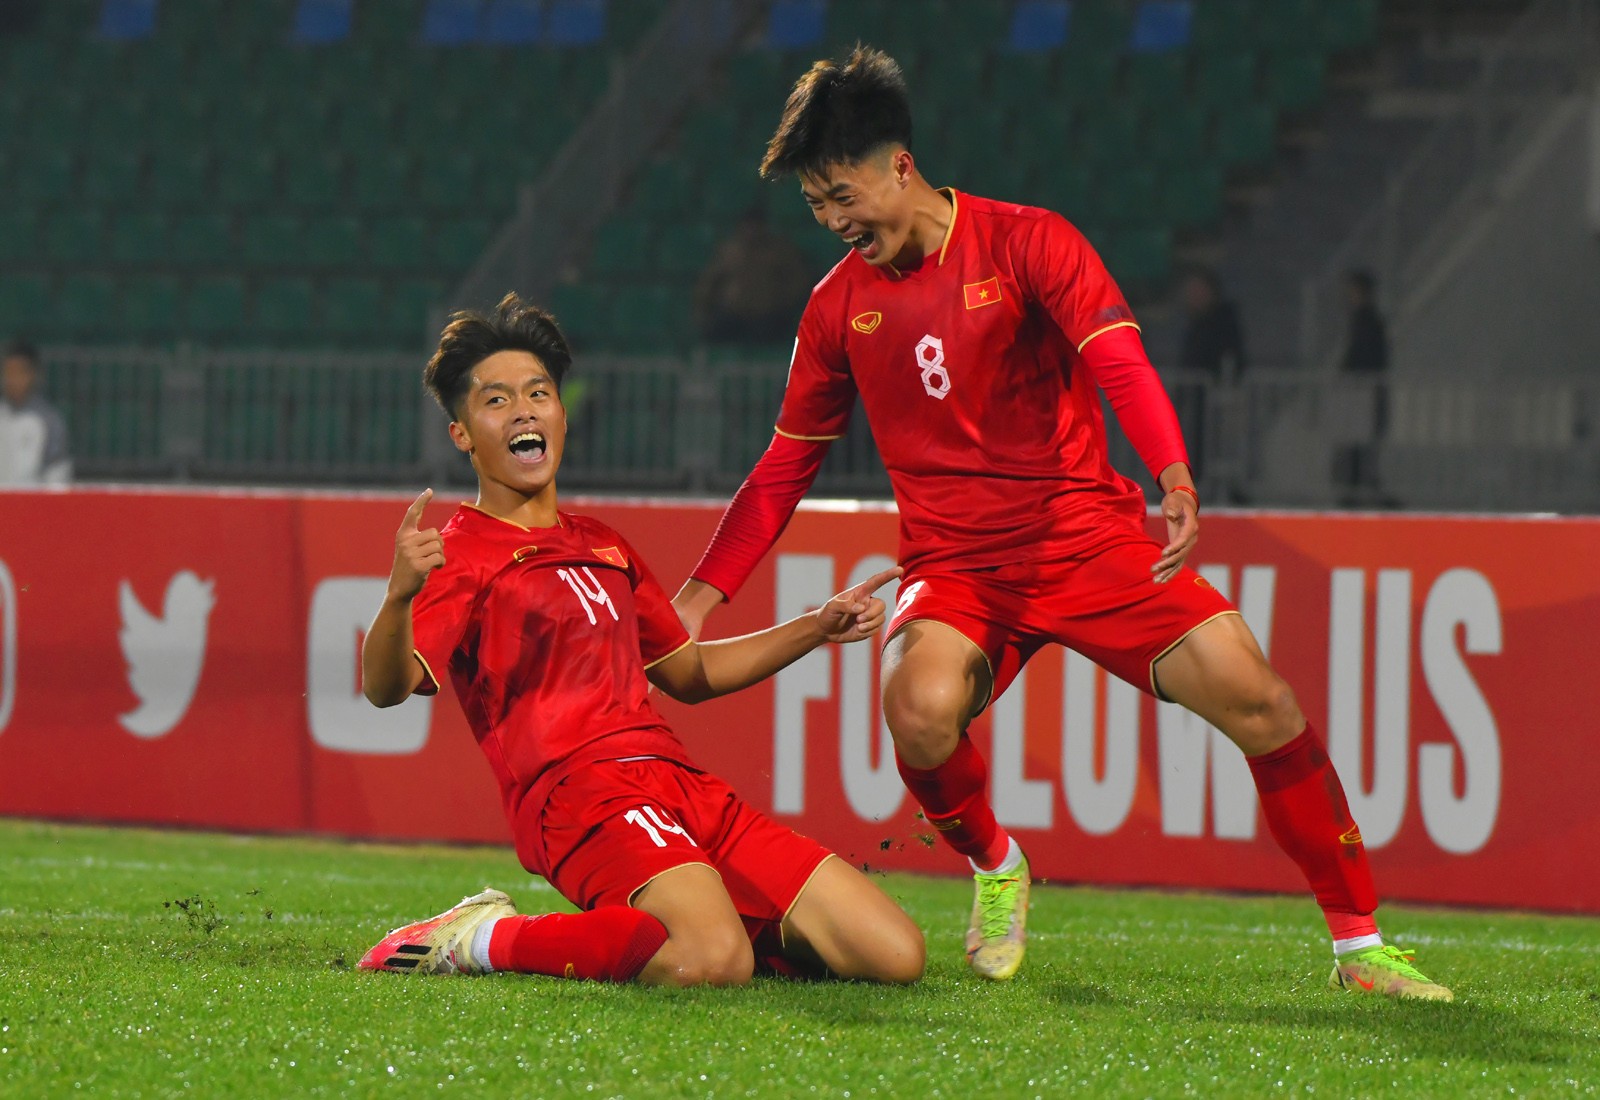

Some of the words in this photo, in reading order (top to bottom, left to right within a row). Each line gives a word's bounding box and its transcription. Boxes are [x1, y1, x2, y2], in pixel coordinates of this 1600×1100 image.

[915, 334, 951, 400] 8
[556, 566, 619, 626] 14
[772, 554, 1277, 841] FOLOW
[1327, 566, 1503, 856] US
[624, 805, 698, 848] 14
